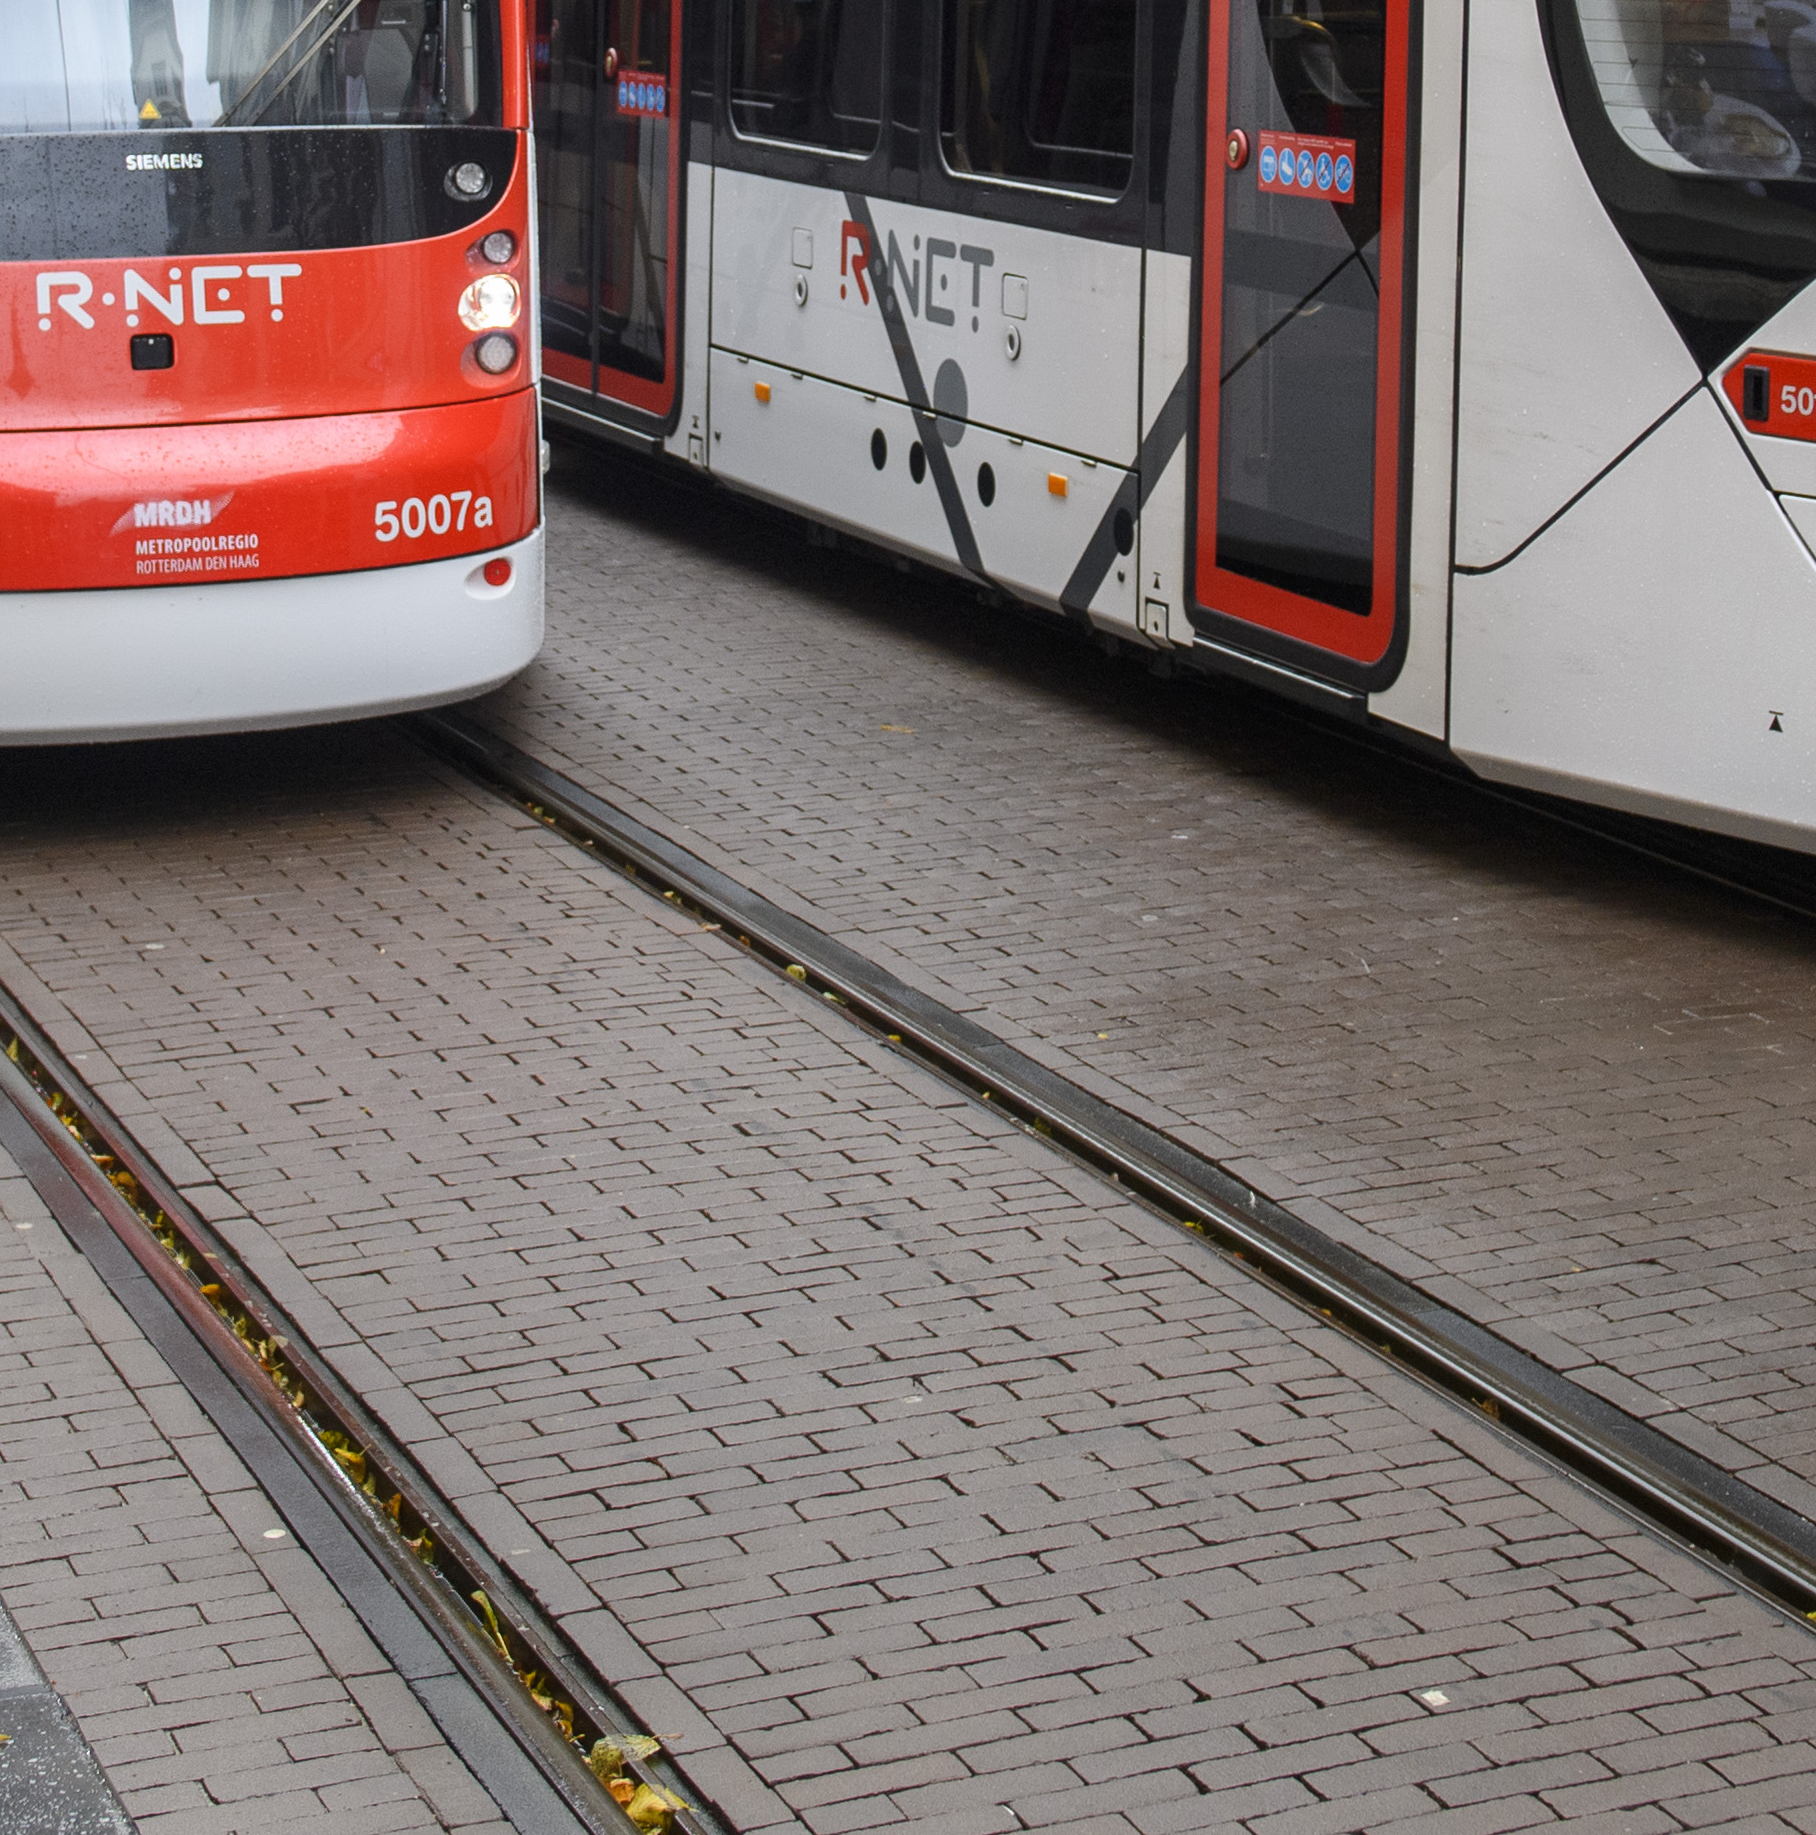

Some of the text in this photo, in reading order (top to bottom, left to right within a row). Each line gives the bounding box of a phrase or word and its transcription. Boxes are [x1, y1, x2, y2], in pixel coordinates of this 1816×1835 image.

[125, 153, 204, 171] SIEMENS
[133, 499, 212, 528] MRDH
[374, 490, 494, 542] 5007a
[135, 532, 259, 556] METROPOOLREGIO
[136, 553, 260, 574] ROTTERDAM DEN HAAG
